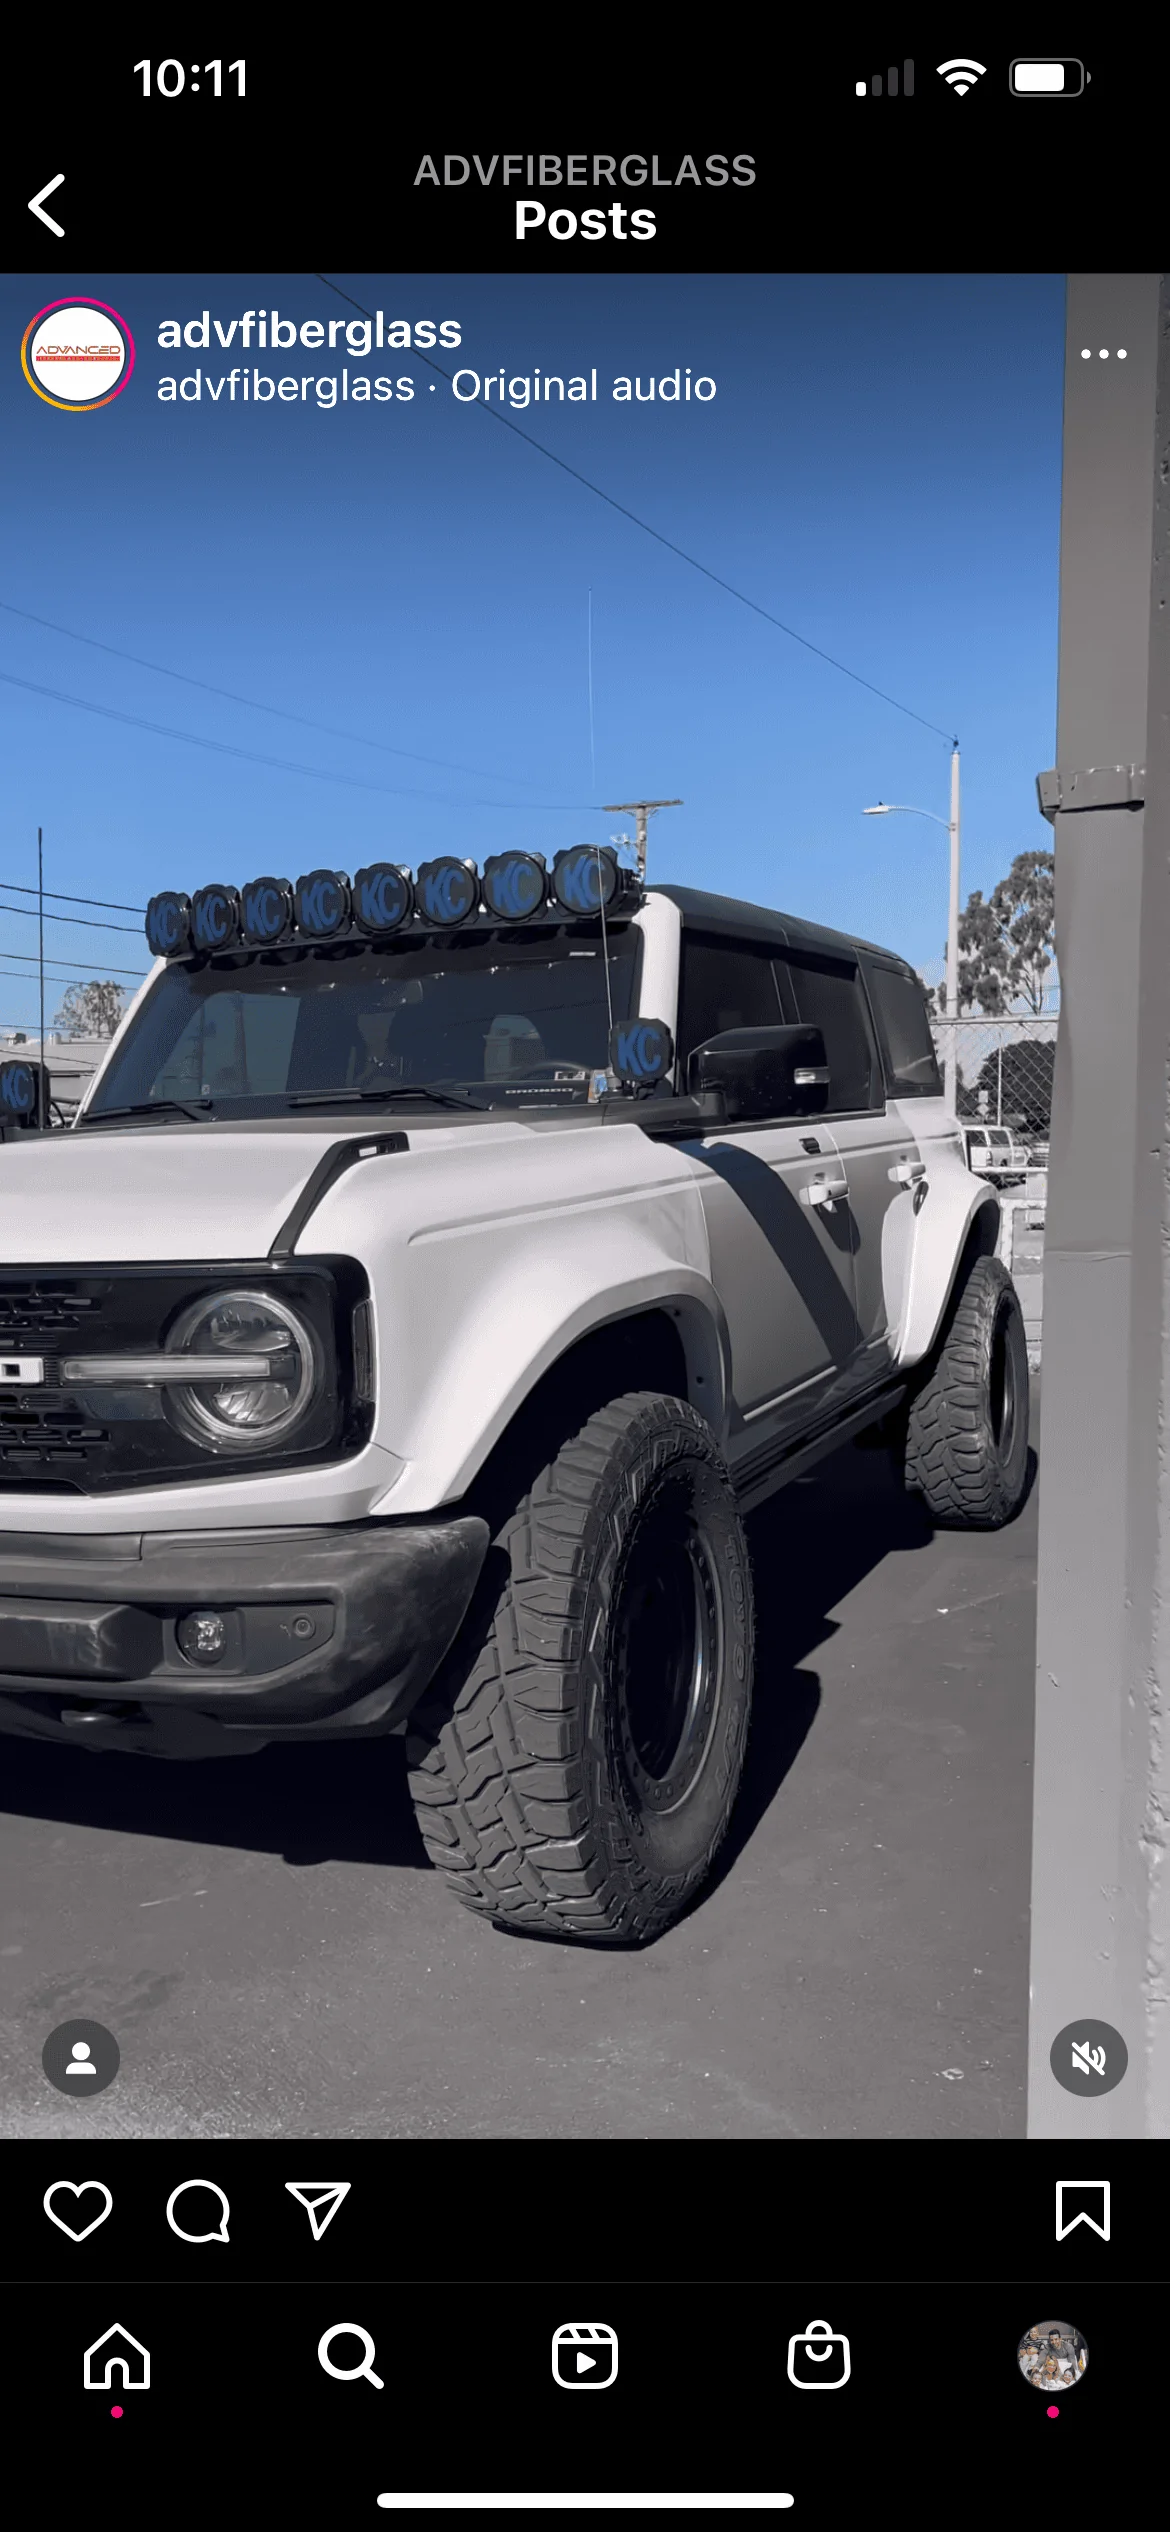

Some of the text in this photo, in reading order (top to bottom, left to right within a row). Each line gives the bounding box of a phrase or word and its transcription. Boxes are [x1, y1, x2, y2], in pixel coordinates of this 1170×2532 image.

[302, 879, 338, 930] KC
[361, 872, 401, 925] KC
[424, 866, 466, 920] KC
[492, 860, 536, 913] KC
[562, 854, 606, 909] KC
[150, 901, 180, 948] KC
[195, 894, 227, 942] KC
[246, 886, 281, 936] KC
[617, 1024, 662, 1077] KC
[2, 1064, 28, 1109] KC
